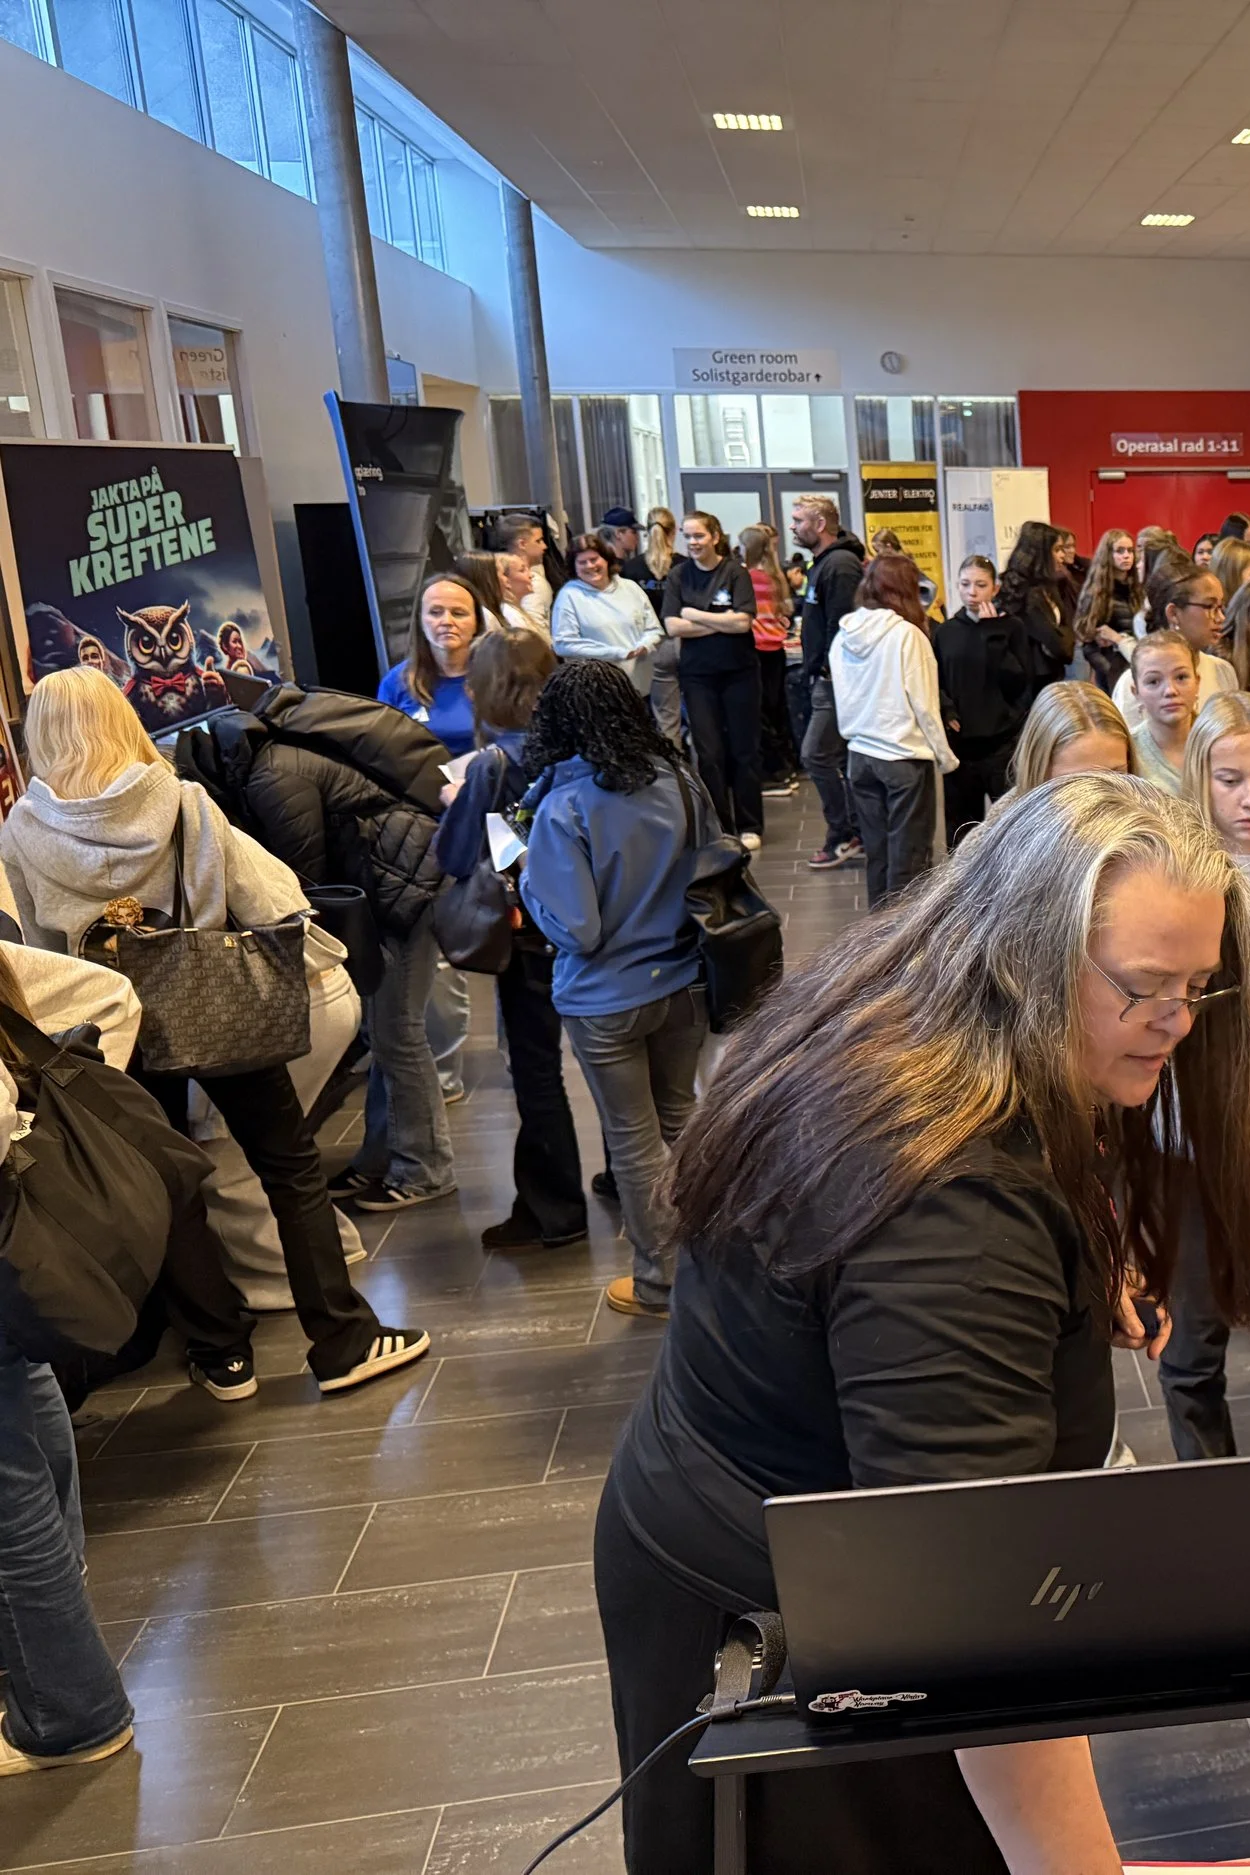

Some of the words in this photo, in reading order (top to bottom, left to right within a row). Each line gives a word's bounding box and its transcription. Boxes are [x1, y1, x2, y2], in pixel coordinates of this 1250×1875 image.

[712, 351, 756, 364] Green
[760, 353, 798, 364] room
[692, 368, 811, 386] Solistgarderobar
[1116, 438, 1178, 456] Operasal
[1181, 437, 1204, 452] rad
[1207, 440, 1240, 452] 1-11
[90, 478, 141, 511] JAKTA
[140, 465, 164, 497] PÅ
[870, 489, 898, 499] JENTER
[952, 503, 991, 512] REALFAG
[87, 490, 186, 552] SUPER
[69, 517, 217, 597] KREFTENE
